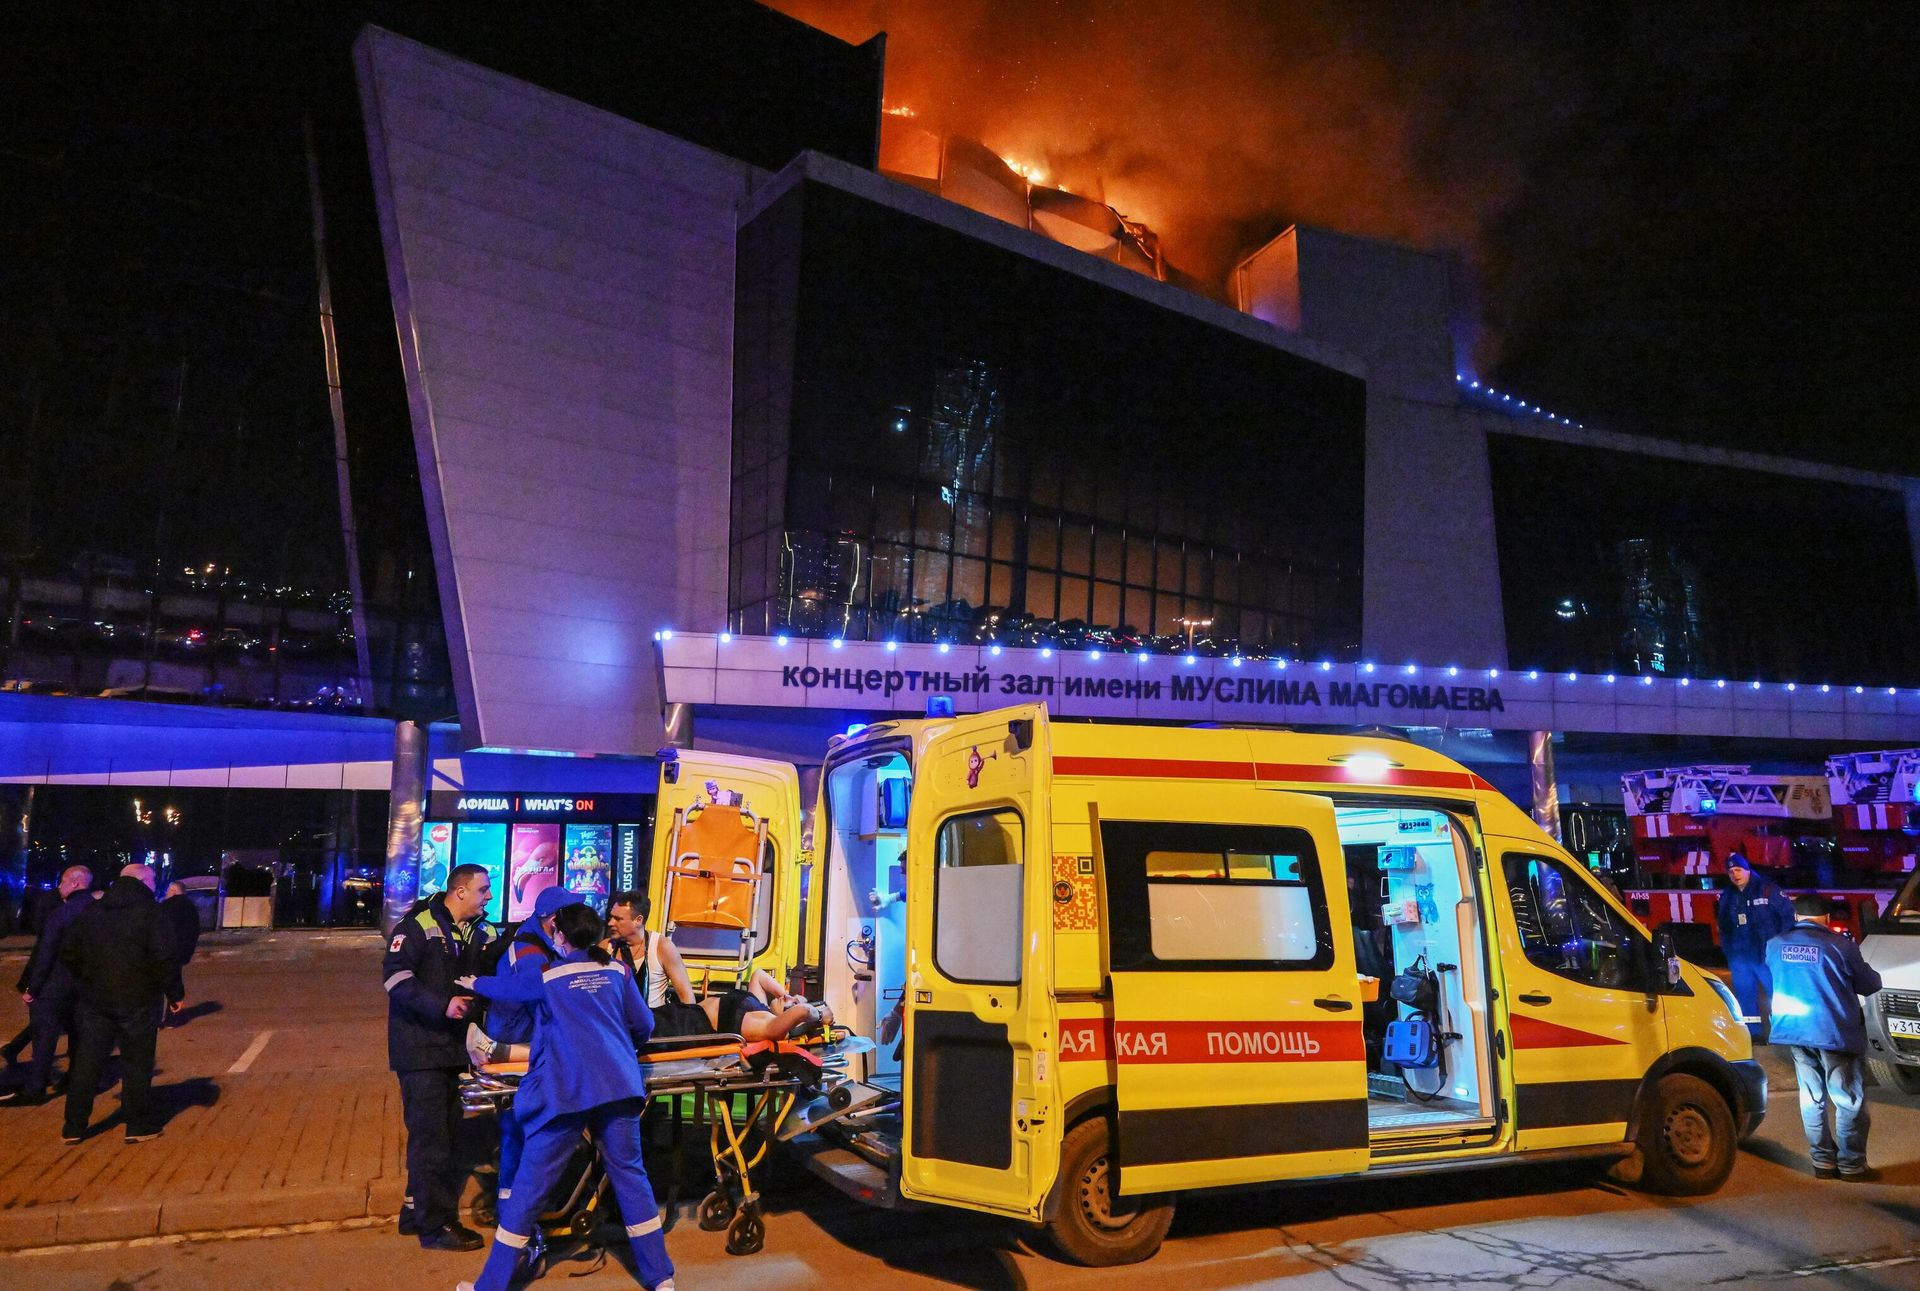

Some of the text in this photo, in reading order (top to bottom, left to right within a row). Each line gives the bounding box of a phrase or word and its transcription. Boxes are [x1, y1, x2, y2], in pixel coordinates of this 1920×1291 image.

[782, 664, 1505, 713] концертный зал имени МУСЛИМА МАГОМАЕВА
[457, 798, 509, 811] АФИША
[525, 799, 593, 811] WHAT'S ON
[624, 830, 634, 853] HALL
[623, 854, 633, 872] CITY
[1782, 946, 1817, 955] СКОРАЯ
[1782, 953, 1817, 962] ПОМОЩЬ
[1117, 1032, 1168, 1056] КАЯ
[1207, 1032, 1320, 1058] ПОМОЩЬ
